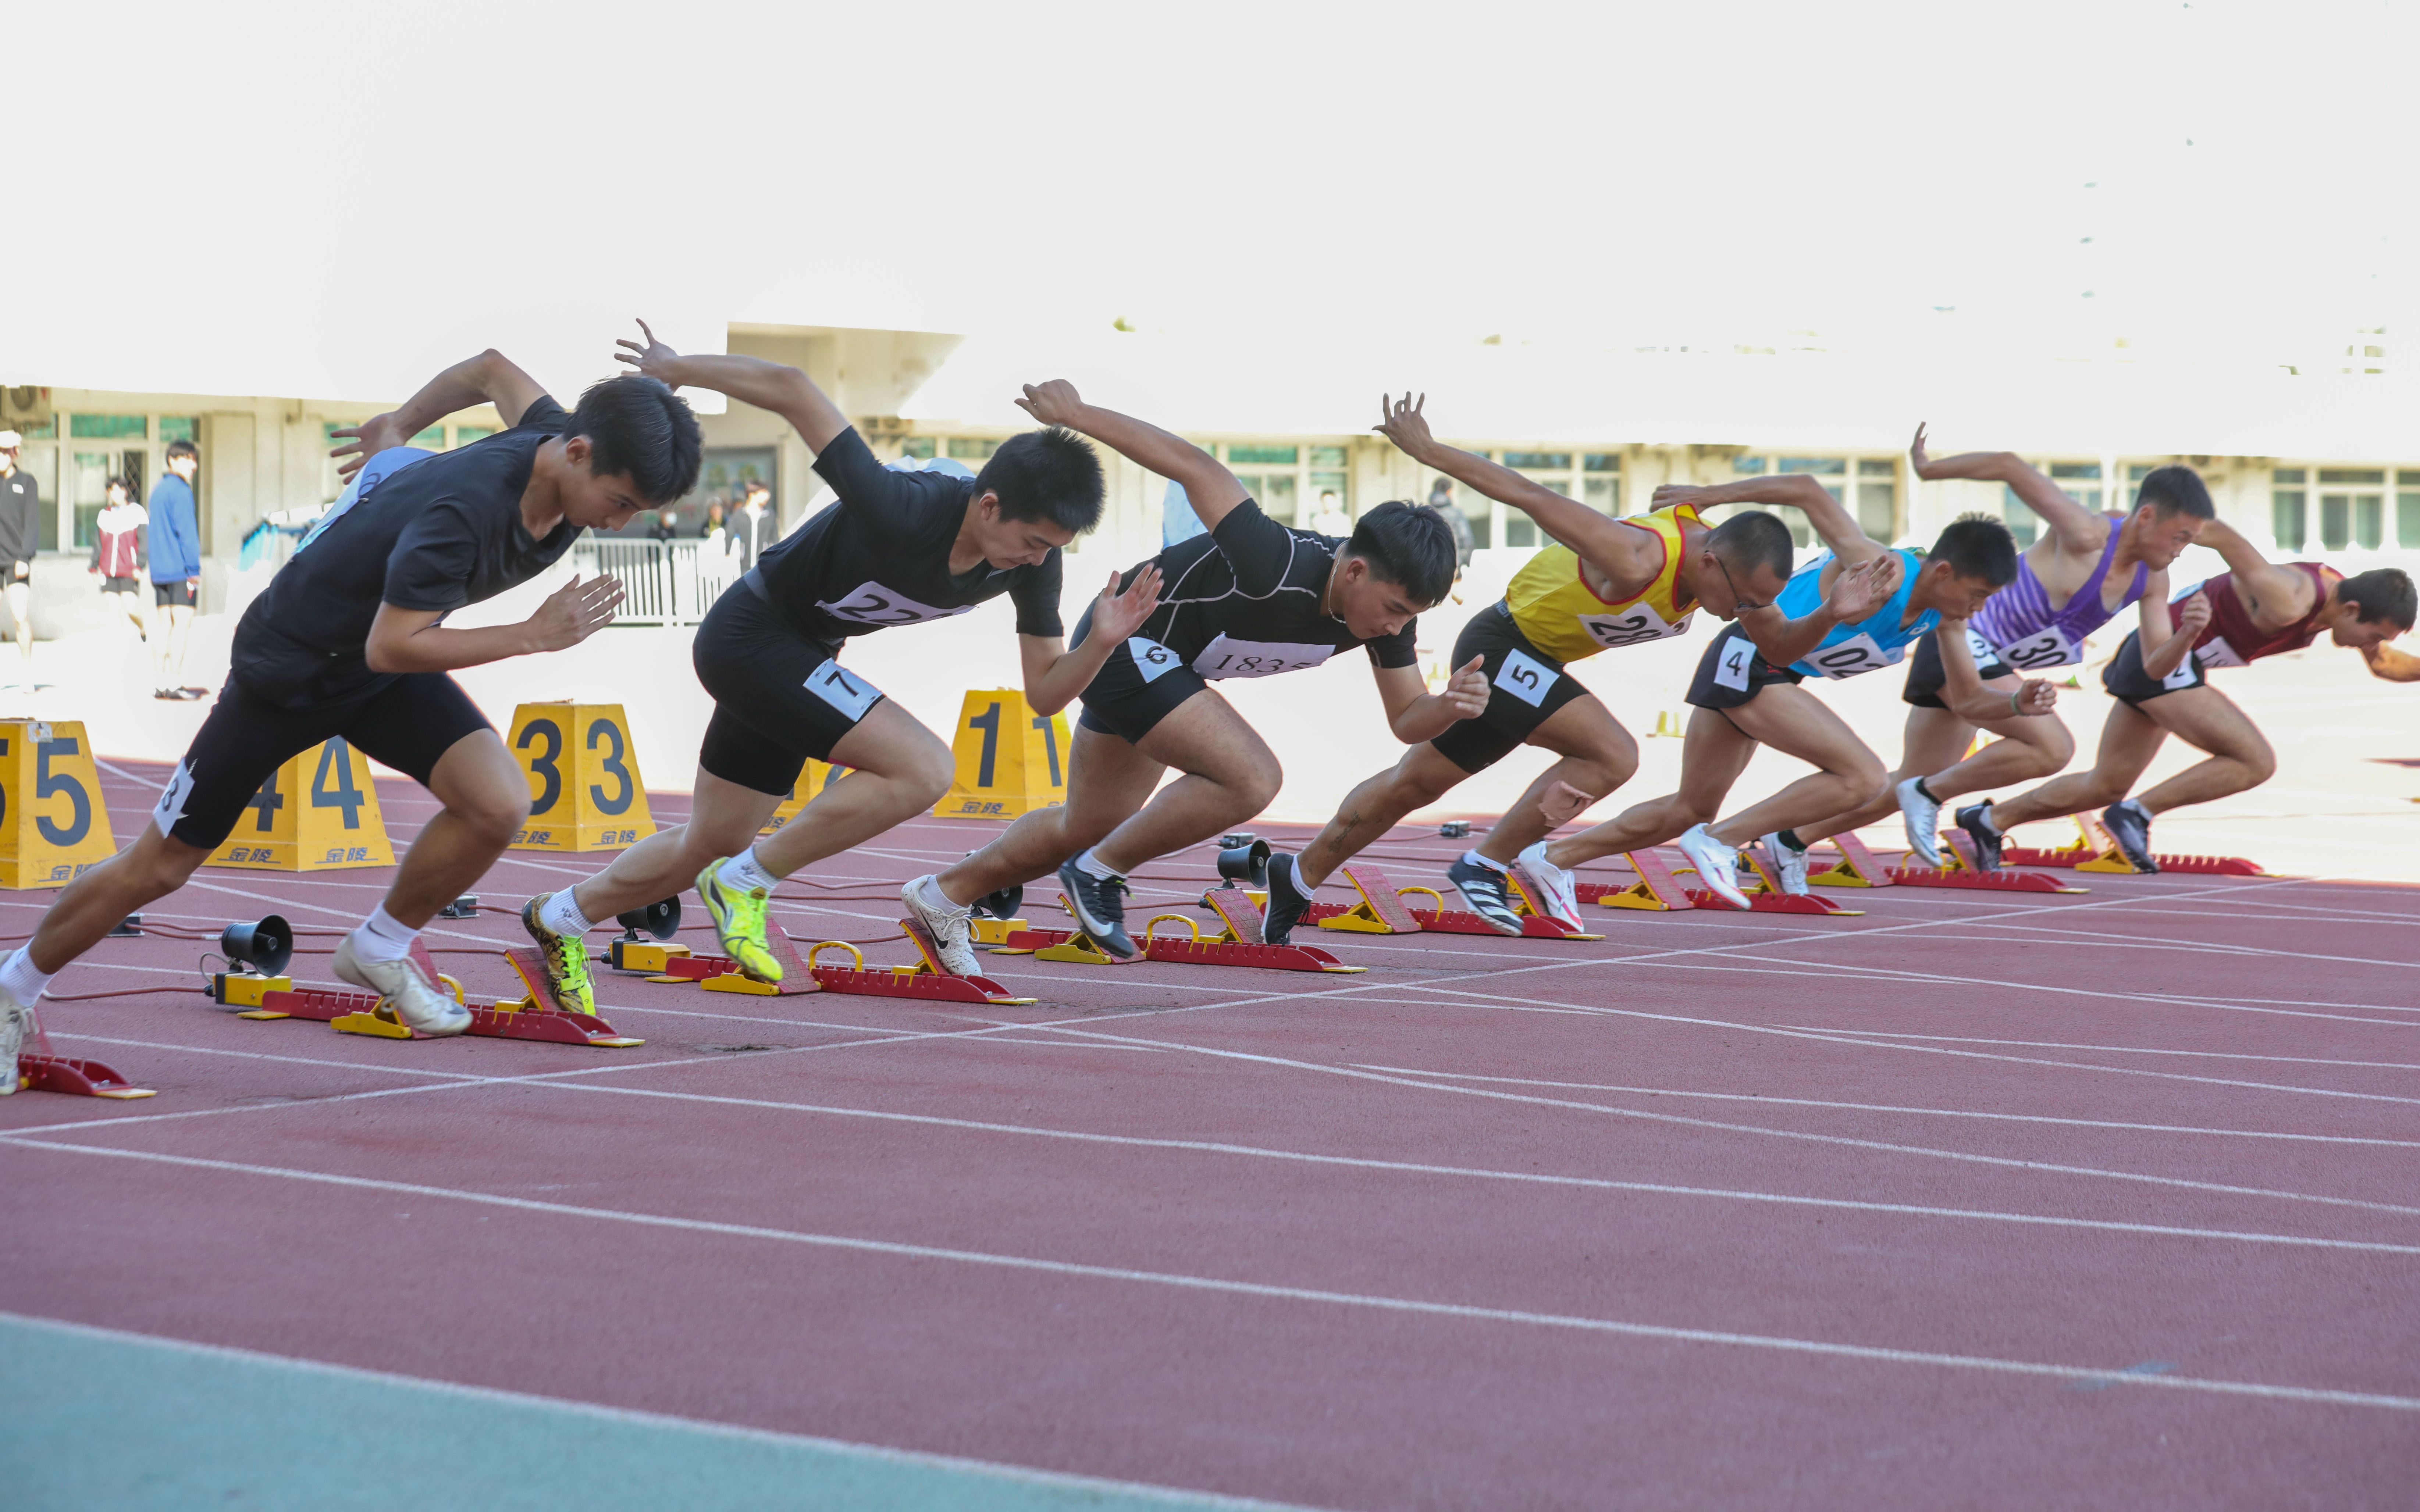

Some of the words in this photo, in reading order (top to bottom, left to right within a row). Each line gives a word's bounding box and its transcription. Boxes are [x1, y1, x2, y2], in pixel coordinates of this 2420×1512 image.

[1146, 646, 1167, 664] 6
[1726, 651, 1743, 676] 4
[823, 670, 859, 697] 7
[1510, 663, 1539, 691] 5
[969, 702, 1001, 788] 1
[1032, 716, 1062, 787] 1
[311, 735, 365, 829] 4
[516, 718, 562, 815] 3
[587, 718, 633, 815] 3
[35, 737, 91, 847] 5
[162, 777, 179, 812] 8
[228, 847, 274, 863] 金陵
[326, 847, 368, 862] 金陵
